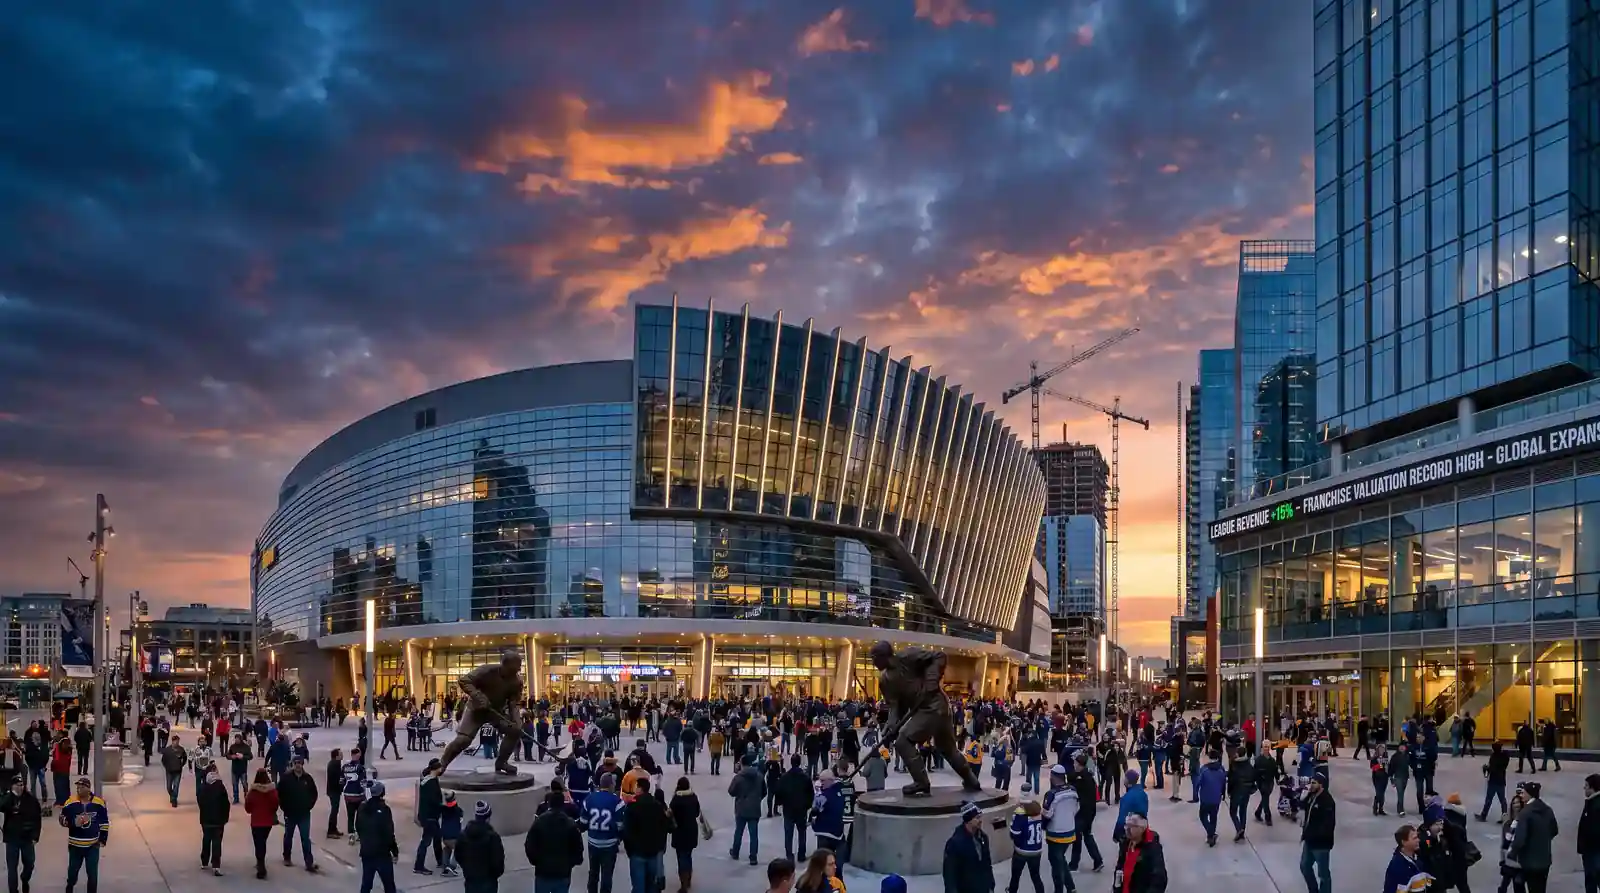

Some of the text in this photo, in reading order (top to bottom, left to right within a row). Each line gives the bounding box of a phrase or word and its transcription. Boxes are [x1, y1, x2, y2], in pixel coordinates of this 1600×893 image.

[1210, 519, 1235, 539] LEAGUE
[1236, 509, 1270, 532] REVENUE
[1271, 503, 1294, 520] +15%
[1303, 486, 1351, 514] FRANCHISE
[1353, 471, 1407, 498] VALUATION
[1409, 459, 1452, 486] RECORD
[1455, 450, 1484, 474] HIGH
[1496, 436, 1547, 464] GLOBAL
[589, 808, 612, 831] 22
